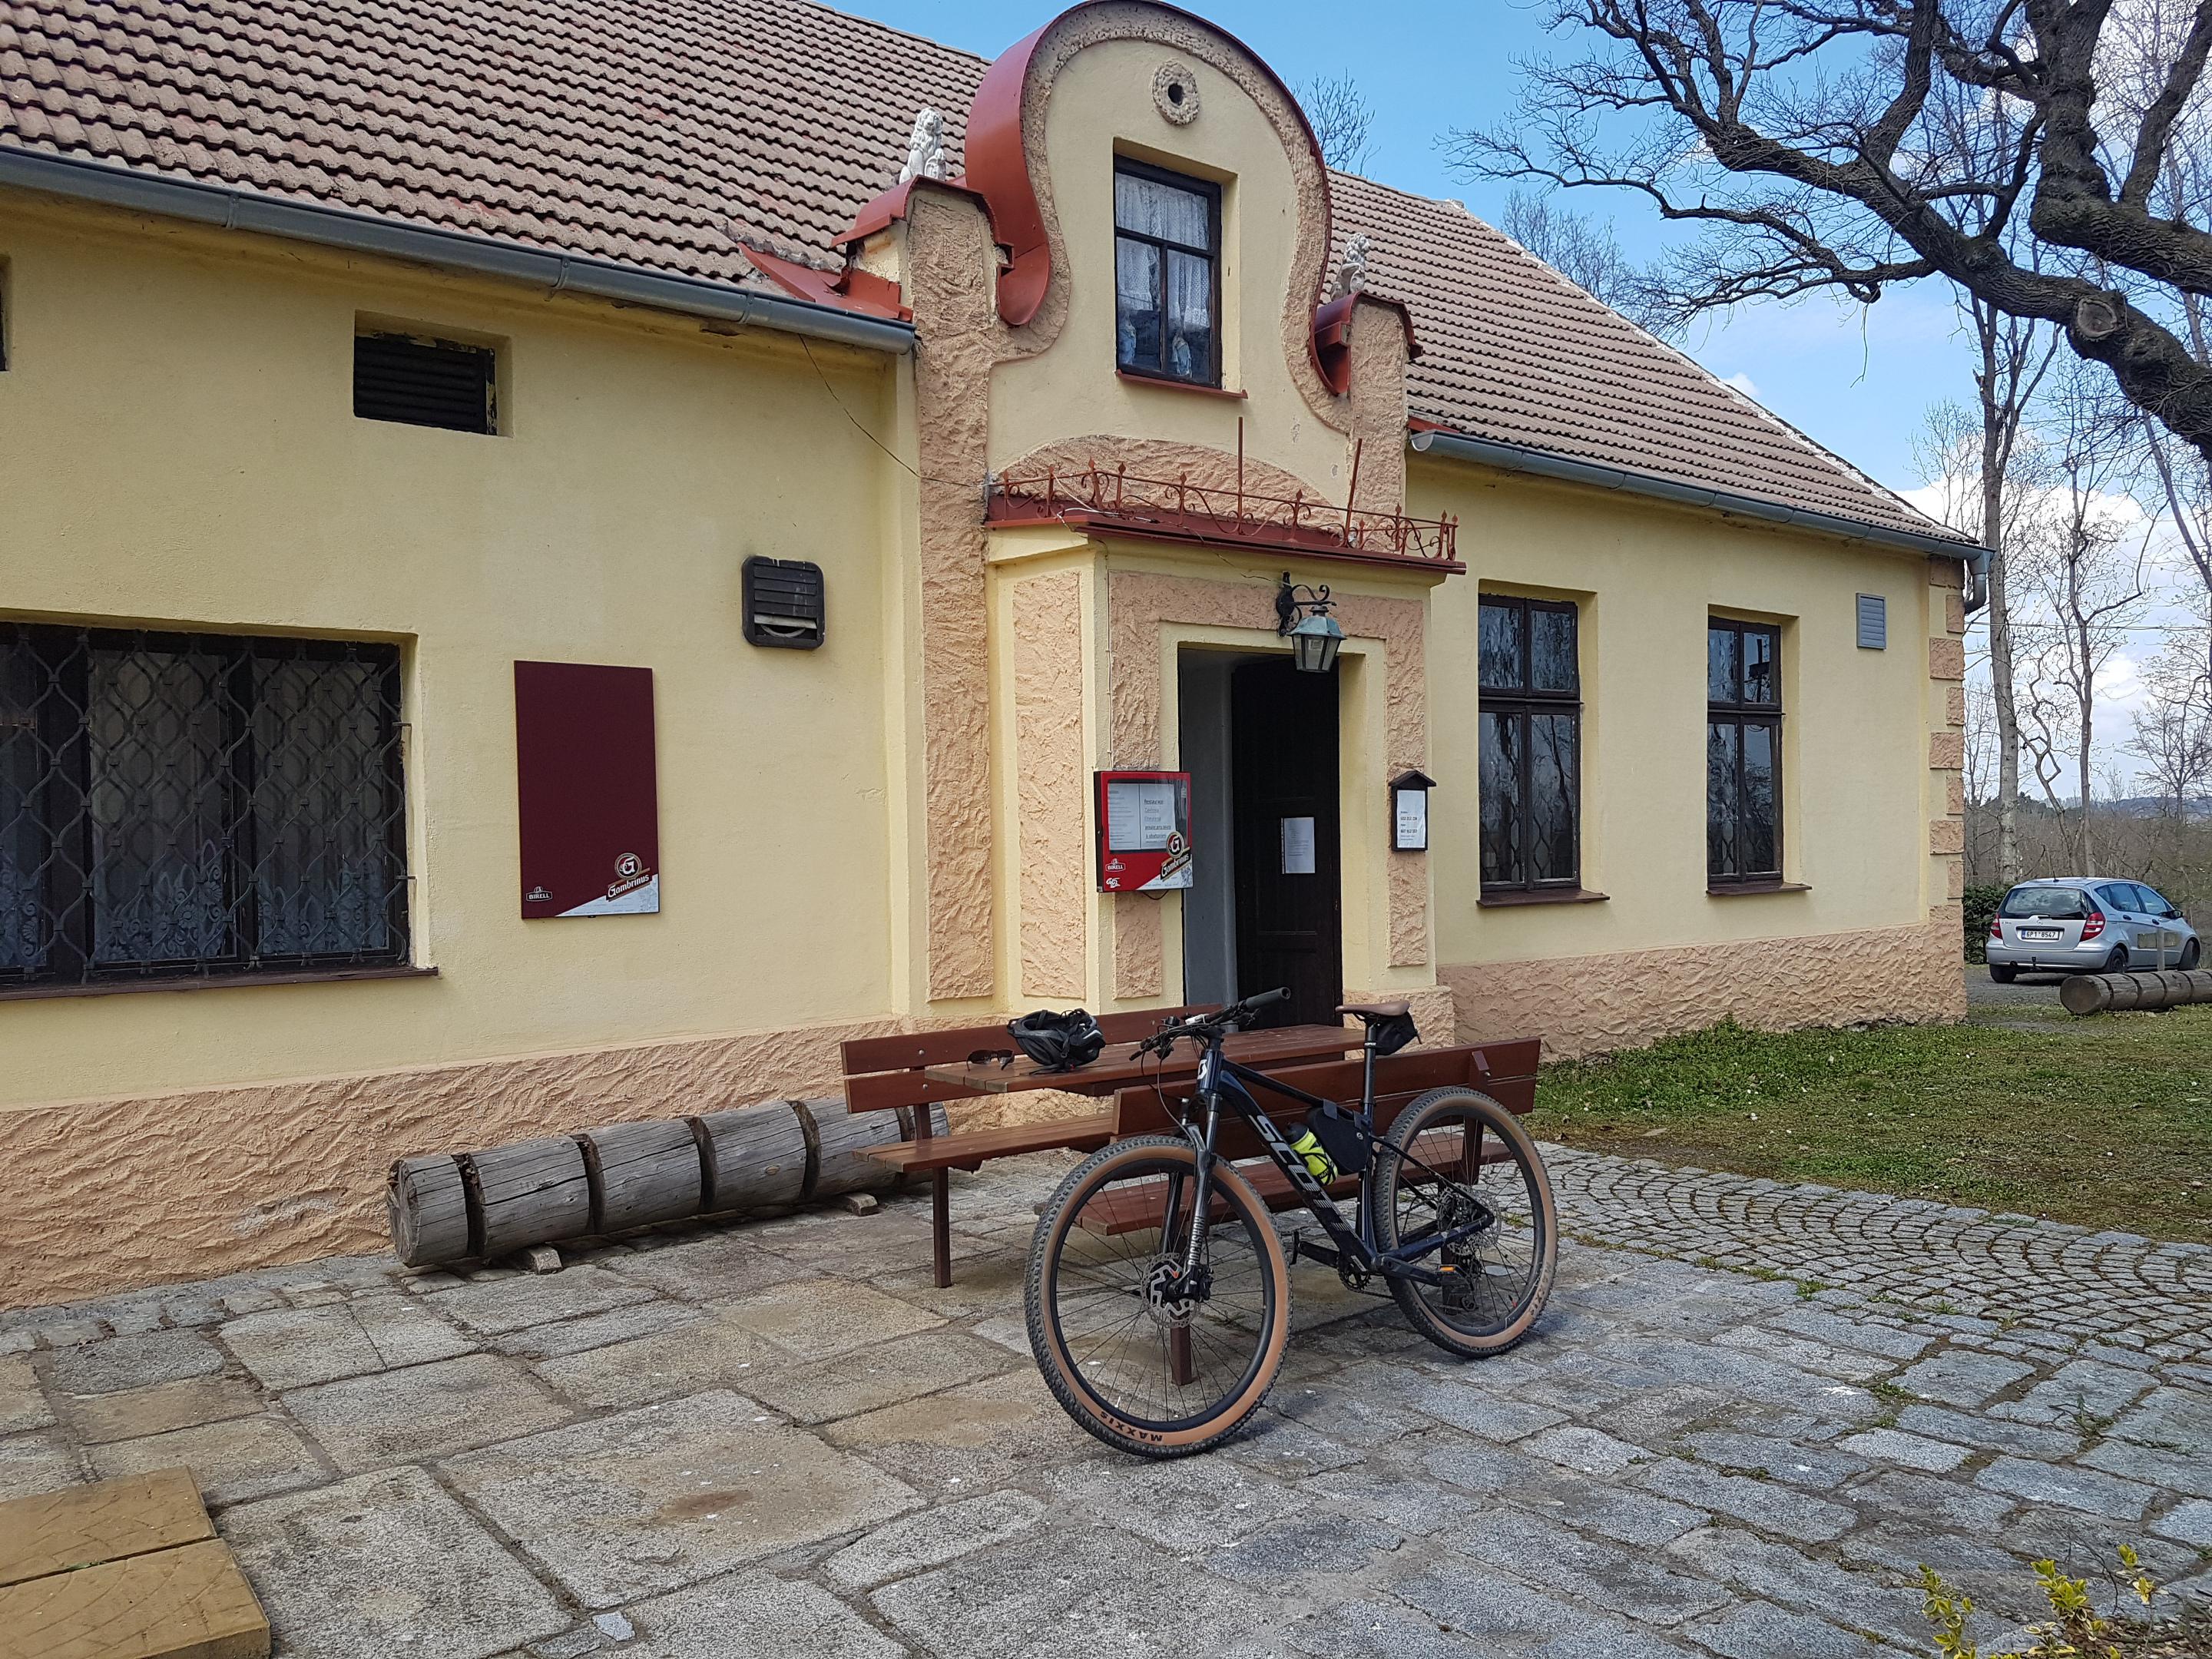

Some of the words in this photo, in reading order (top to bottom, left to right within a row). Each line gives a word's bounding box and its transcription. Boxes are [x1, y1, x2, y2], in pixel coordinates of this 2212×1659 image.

[1161, 853, 1189, 876] Gambrinus
[608, 875, 650, 898] Gambrinus
[1247, 1114, 1356, 1233] SCOTT
[1100, 1411, 1163, 1442] MAXXIS
